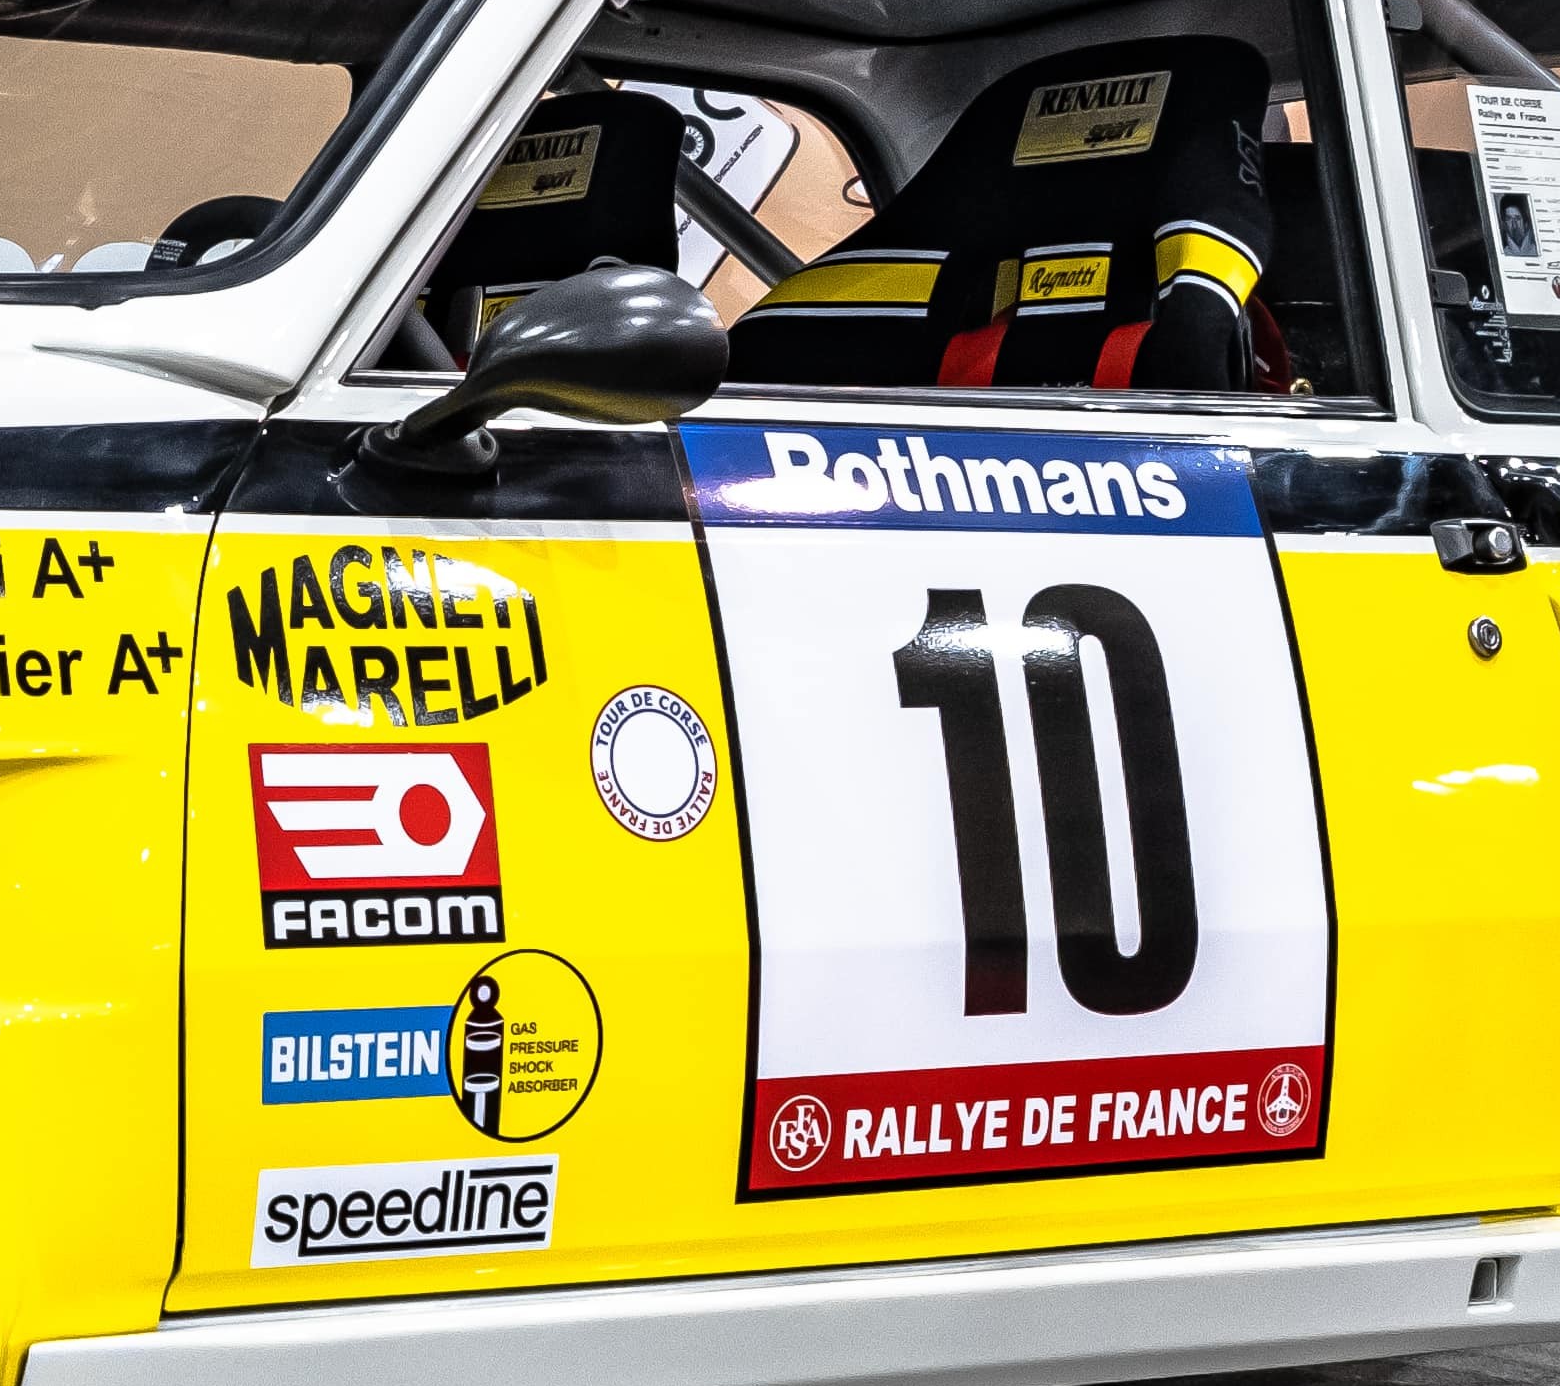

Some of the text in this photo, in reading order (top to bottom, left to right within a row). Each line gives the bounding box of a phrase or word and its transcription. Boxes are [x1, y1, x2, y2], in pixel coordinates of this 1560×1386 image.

[1038, 76, 1156, 117] RENAULT
[1475, 95, 1498, 106] TOUR
[1029, 262, 1101, 296] Ragnotti
[764, 430, 1187, 519] Rothmans
[31, 537, 116, 599] A+
[106, 630, 185, 696] A+
[595, 691, 708, 748] TOUR DE CORSE
[596, 769, 713, 835] RALLYE DE FRANCE
[892, 583, 1201, 1018] 10
[271, 893, 499, 940] FACOM
[509, 1039, 579, 1054] PRESSURE
[510, 1022, 537, 1035] GAS
[270, 1029, 441, 1084] BILSTEIN
[509, 1060, 554, 1074] SHOCK
[507, 1078, 578, 1093] ABSORBER
[843, 1083, 1250, 1161] RALLYE DE FRANCE
[265, 1165, 554, 1258] speedline
